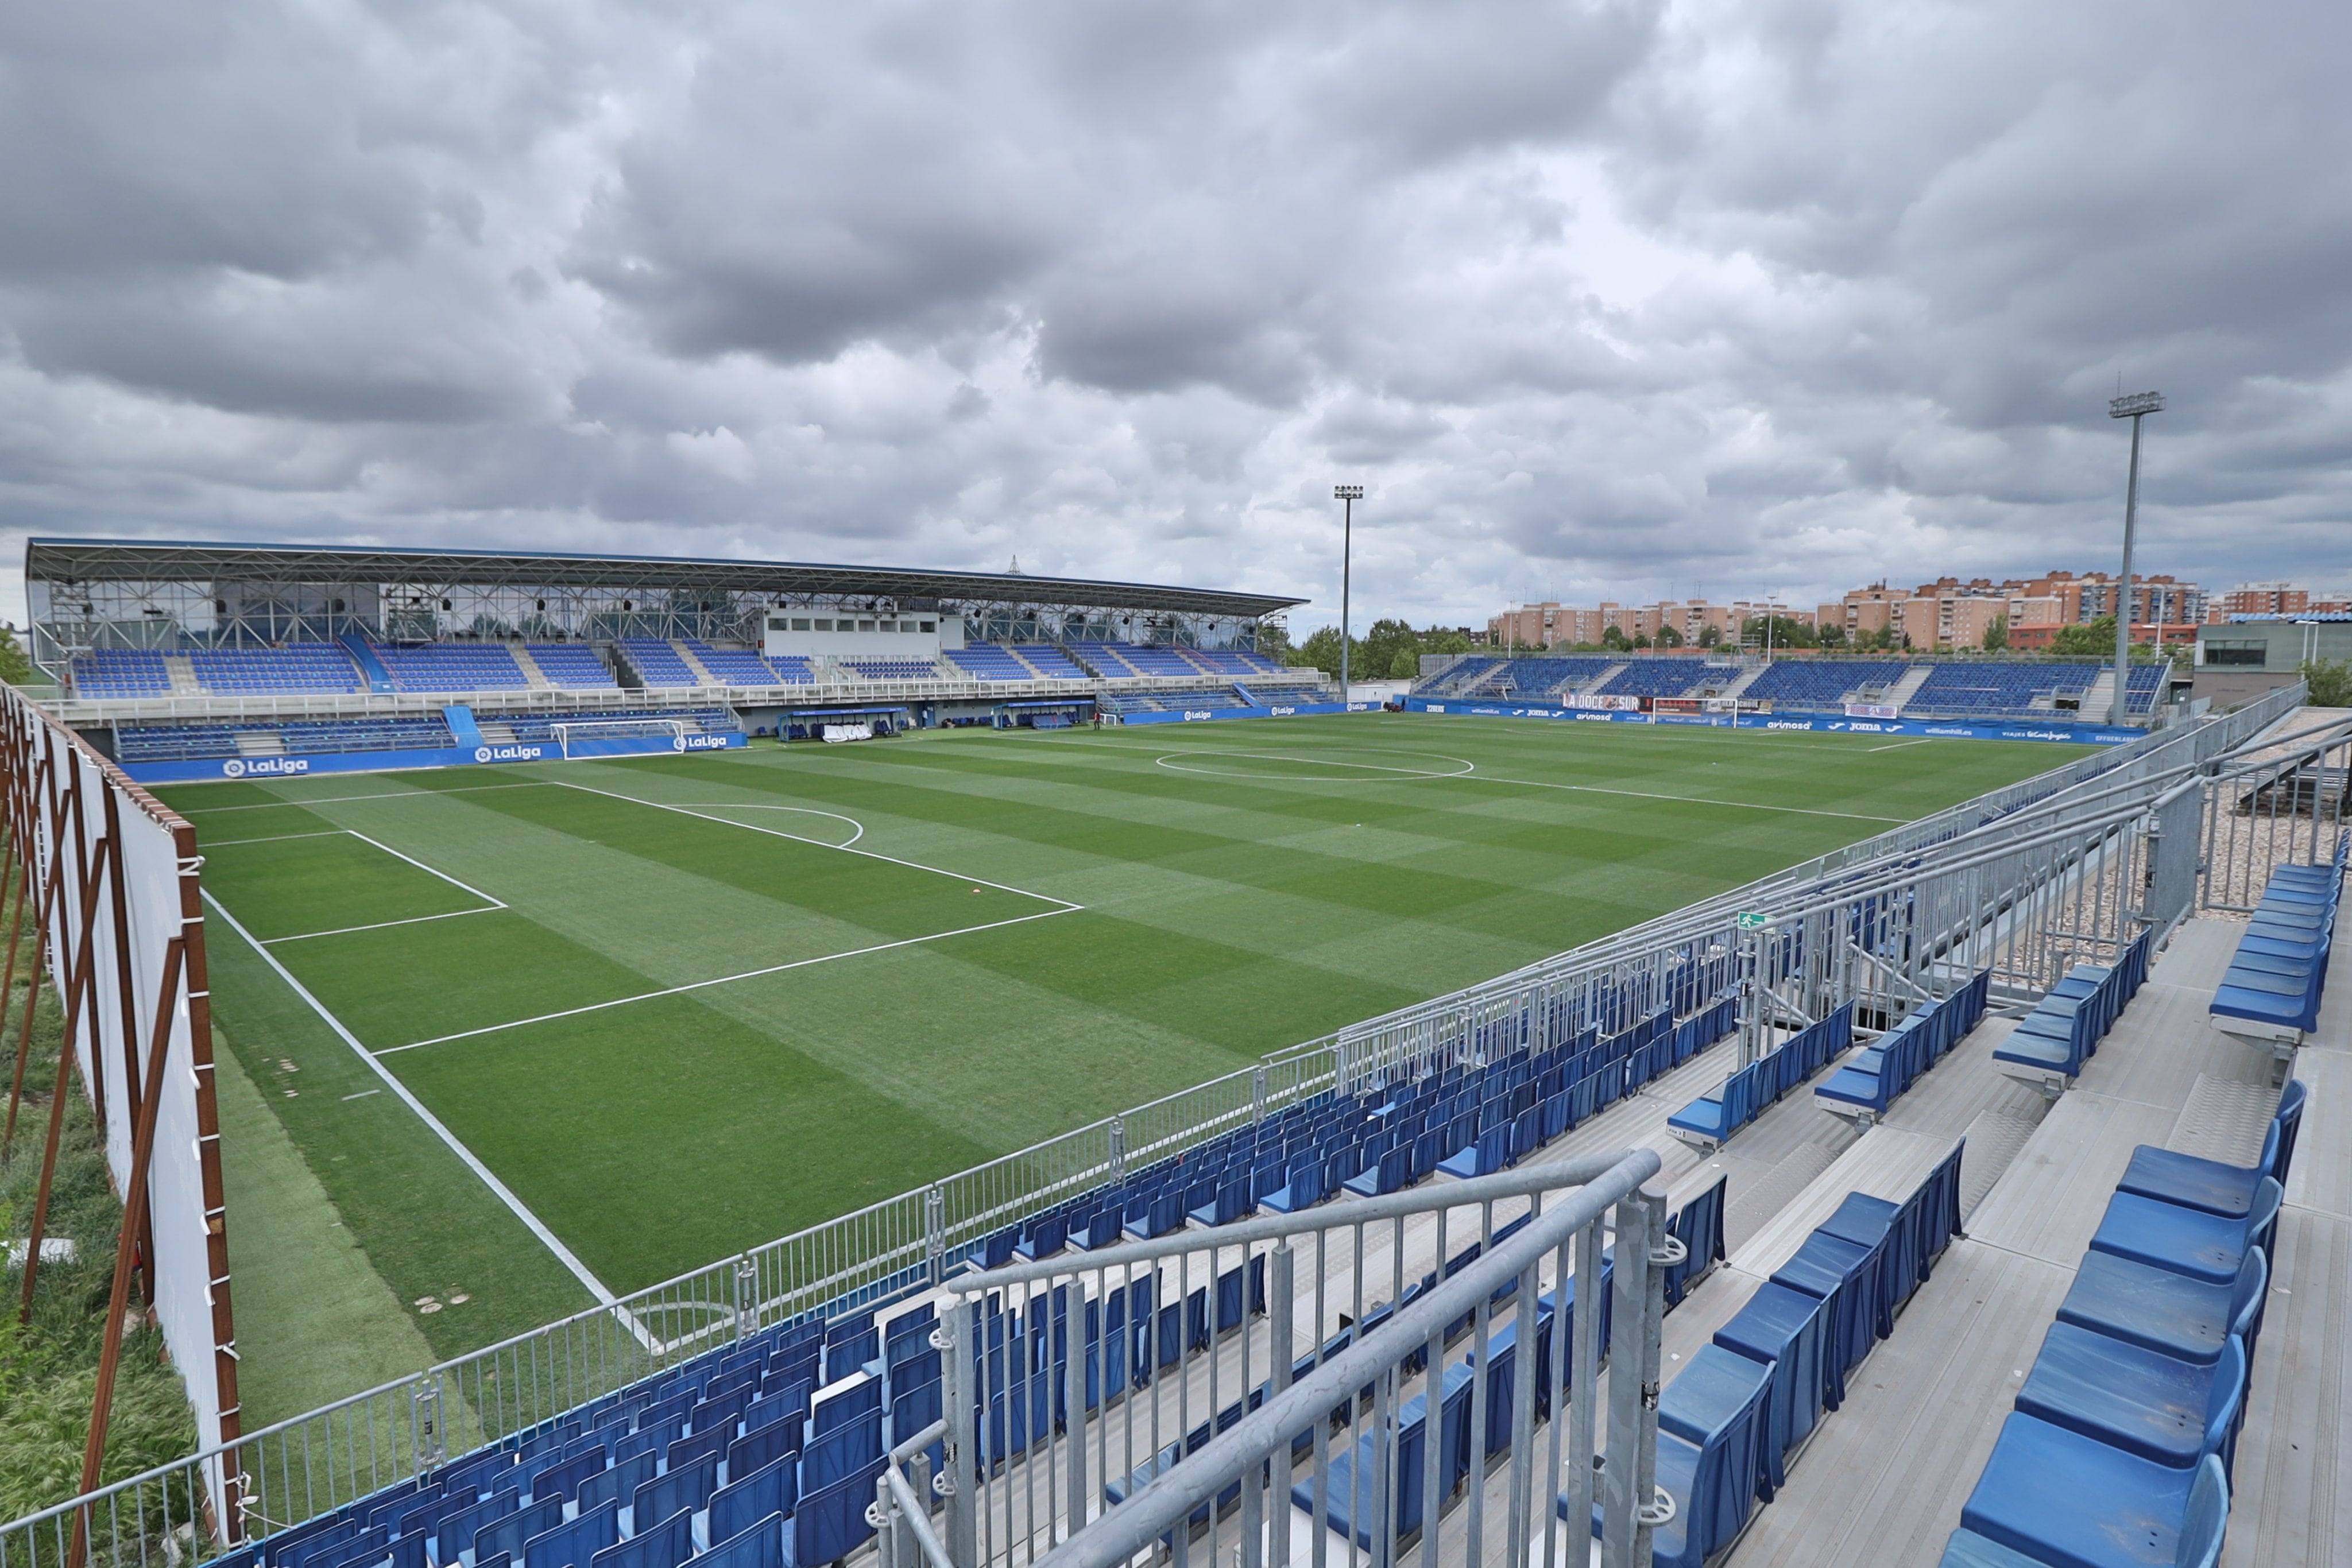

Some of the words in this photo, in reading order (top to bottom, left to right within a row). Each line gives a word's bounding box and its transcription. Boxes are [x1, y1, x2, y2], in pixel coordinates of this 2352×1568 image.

[1352, 703, 1367, 711] LaLiga
[1562, 694, 1576, 707] LA
[1579, 695, 1603, 709] DOCE
[1619, 696, 1639, 711] SUR
[1192, 711, 1211, 720] LaLiga
[1278, 706, 1295, 715] LaLiga
[1925, 727, 1972, 735] williamhill.es
[688, 735, 726, 748] LaLiga
[494, 745, 541, 760] LaLiga
[247, 758, 308, 773] LaLiga
